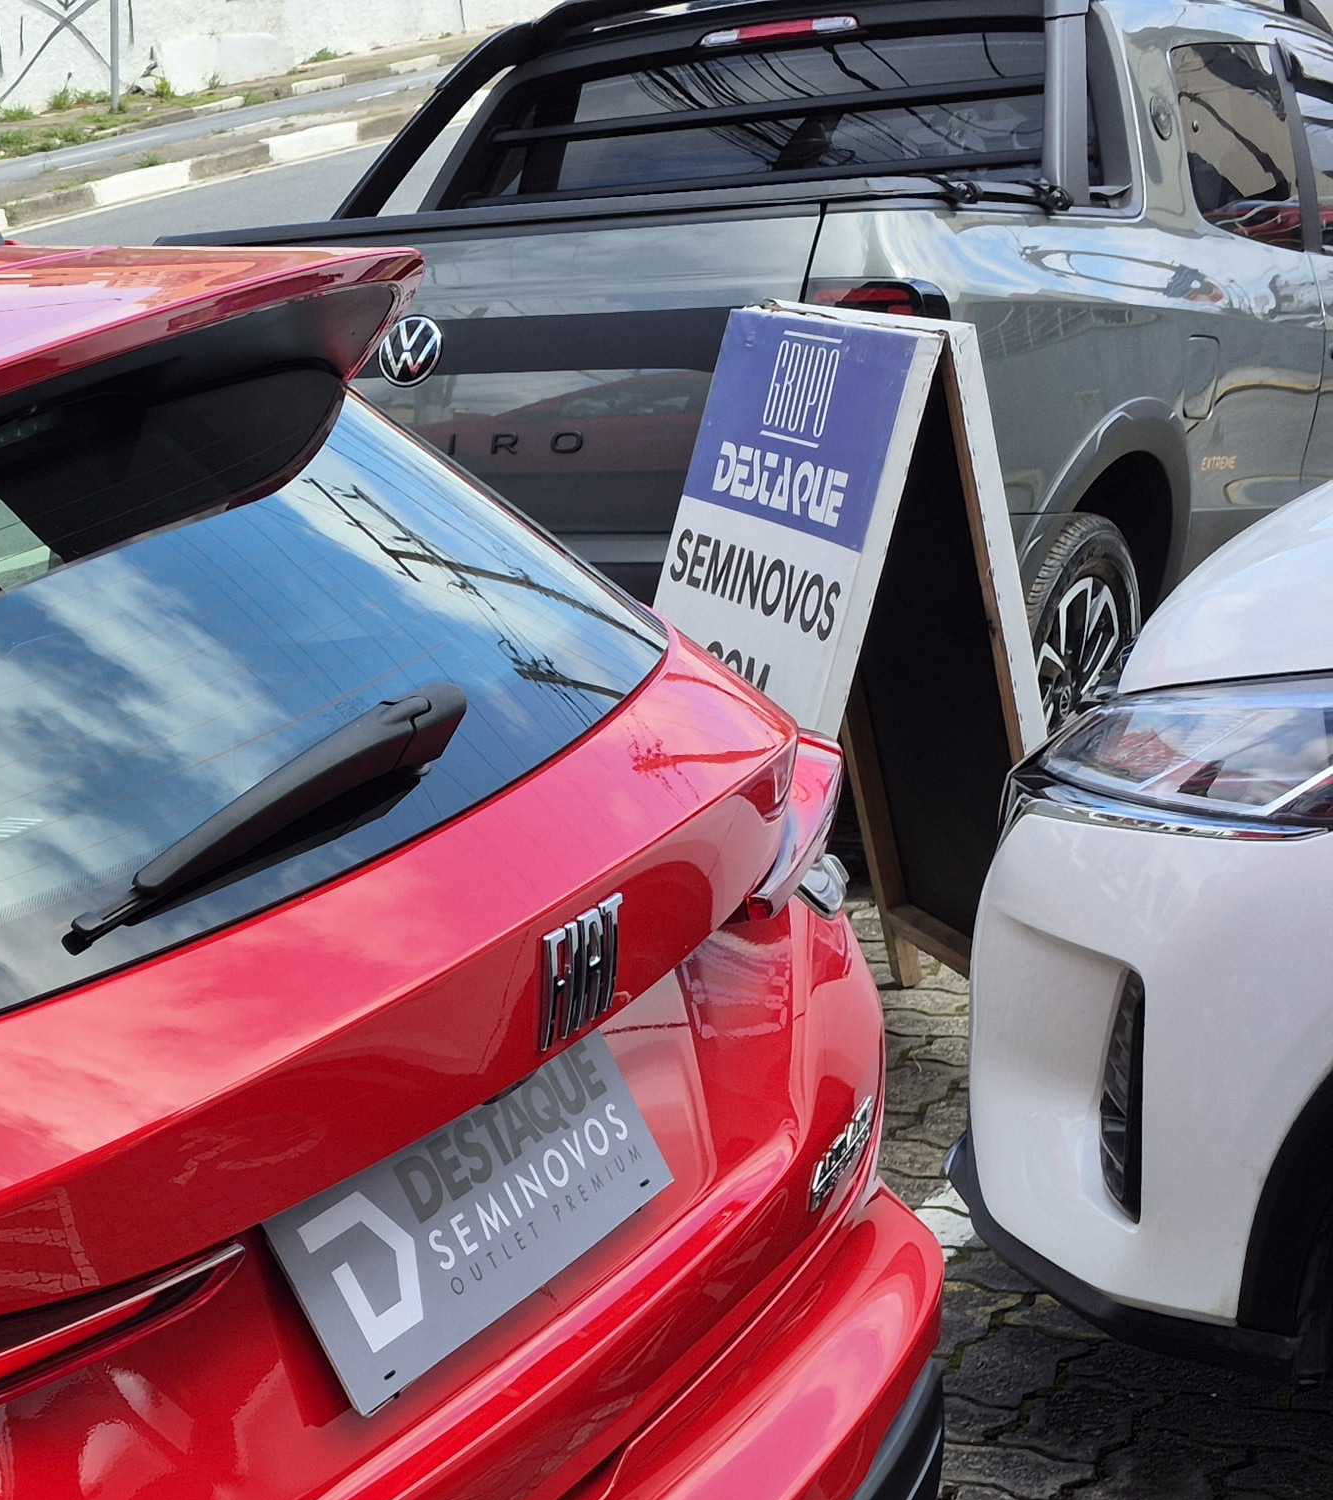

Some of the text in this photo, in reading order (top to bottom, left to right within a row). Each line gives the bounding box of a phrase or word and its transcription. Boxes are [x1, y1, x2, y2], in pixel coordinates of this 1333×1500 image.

[762, 339, 840, 438] GRUPO
[712, 441, 849, 528] DESTAQUE
[1201, 455, 1237, 471] EXTREME
[670, 528, 841, 642] SEMINOVOS
[540, 892, 623, 1052] FIAT
[392, 1042, 608, 1225] DESTAQUE
[428, 1102, 628, 1271] SEMINOVOS
[450, 1145, 642, 1295] OUTLET PREMIUM
